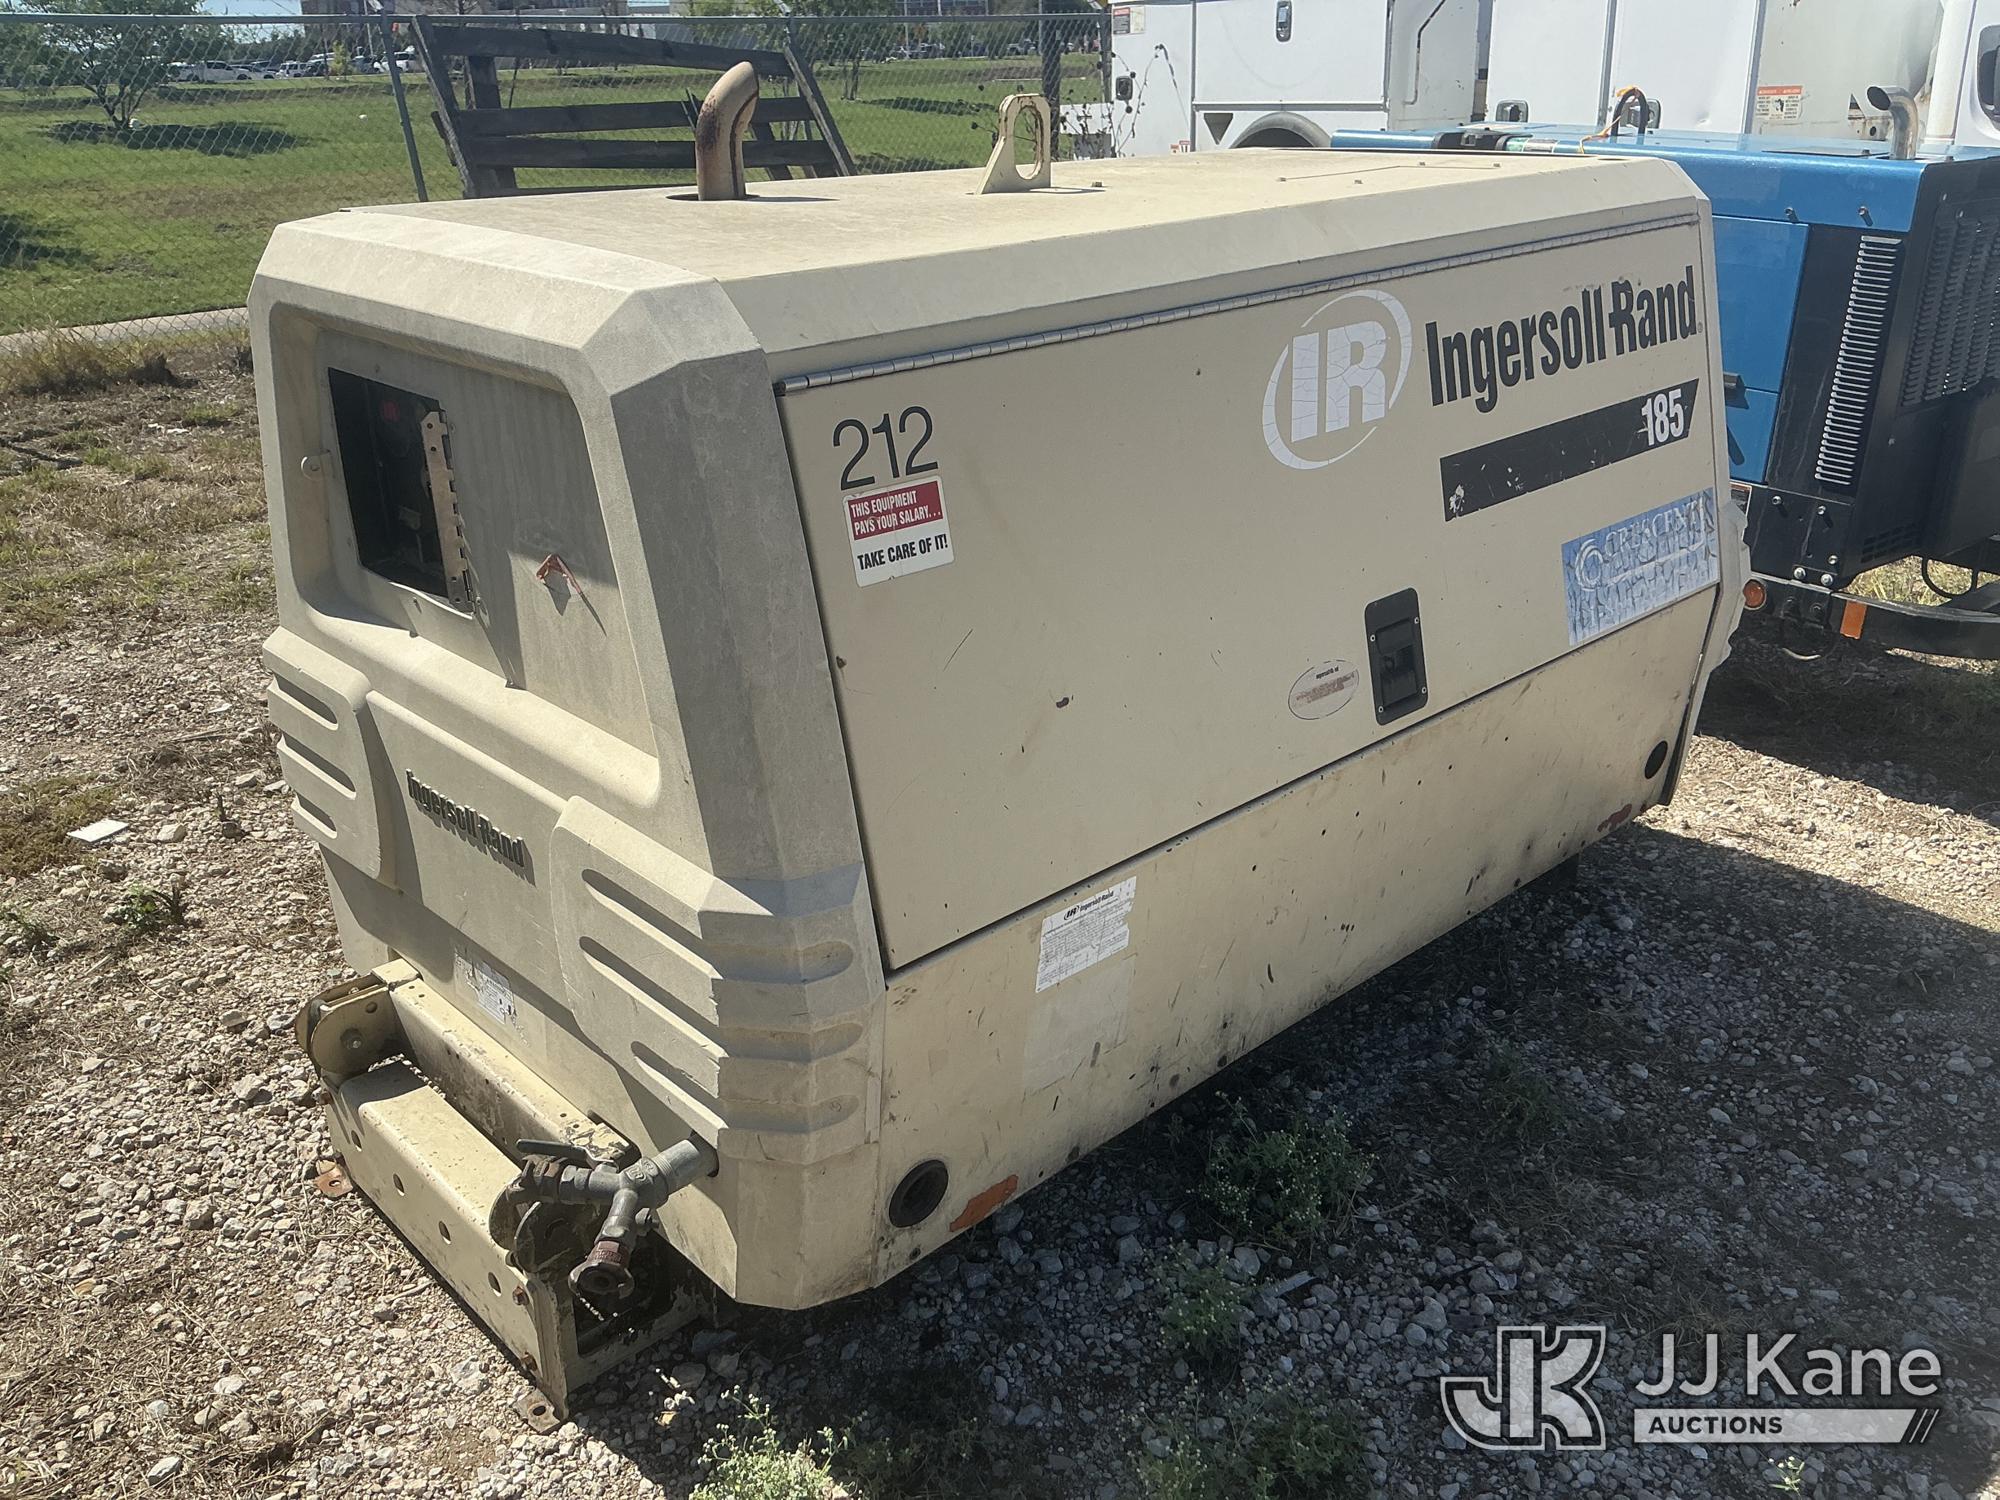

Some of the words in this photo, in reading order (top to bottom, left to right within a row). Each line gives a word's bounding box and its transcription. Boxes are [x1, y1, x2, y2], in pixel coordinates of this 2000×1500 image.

[1641, 388, 1686, 446] 185
[832, 405, 939, 491] 212
[850, 501, 871, 519] THIS
[871, 490, 917, 514] EQUIPMENT
[854, 518, 876, 536] PAYS
[876, 513, 898, 531] YOUR
[857, 549, 886, 571] TAKE
[887, 541, 917, 563] CARE
[918, 537, 932, 555] OF
[934, 533, 949, 551] IT!
